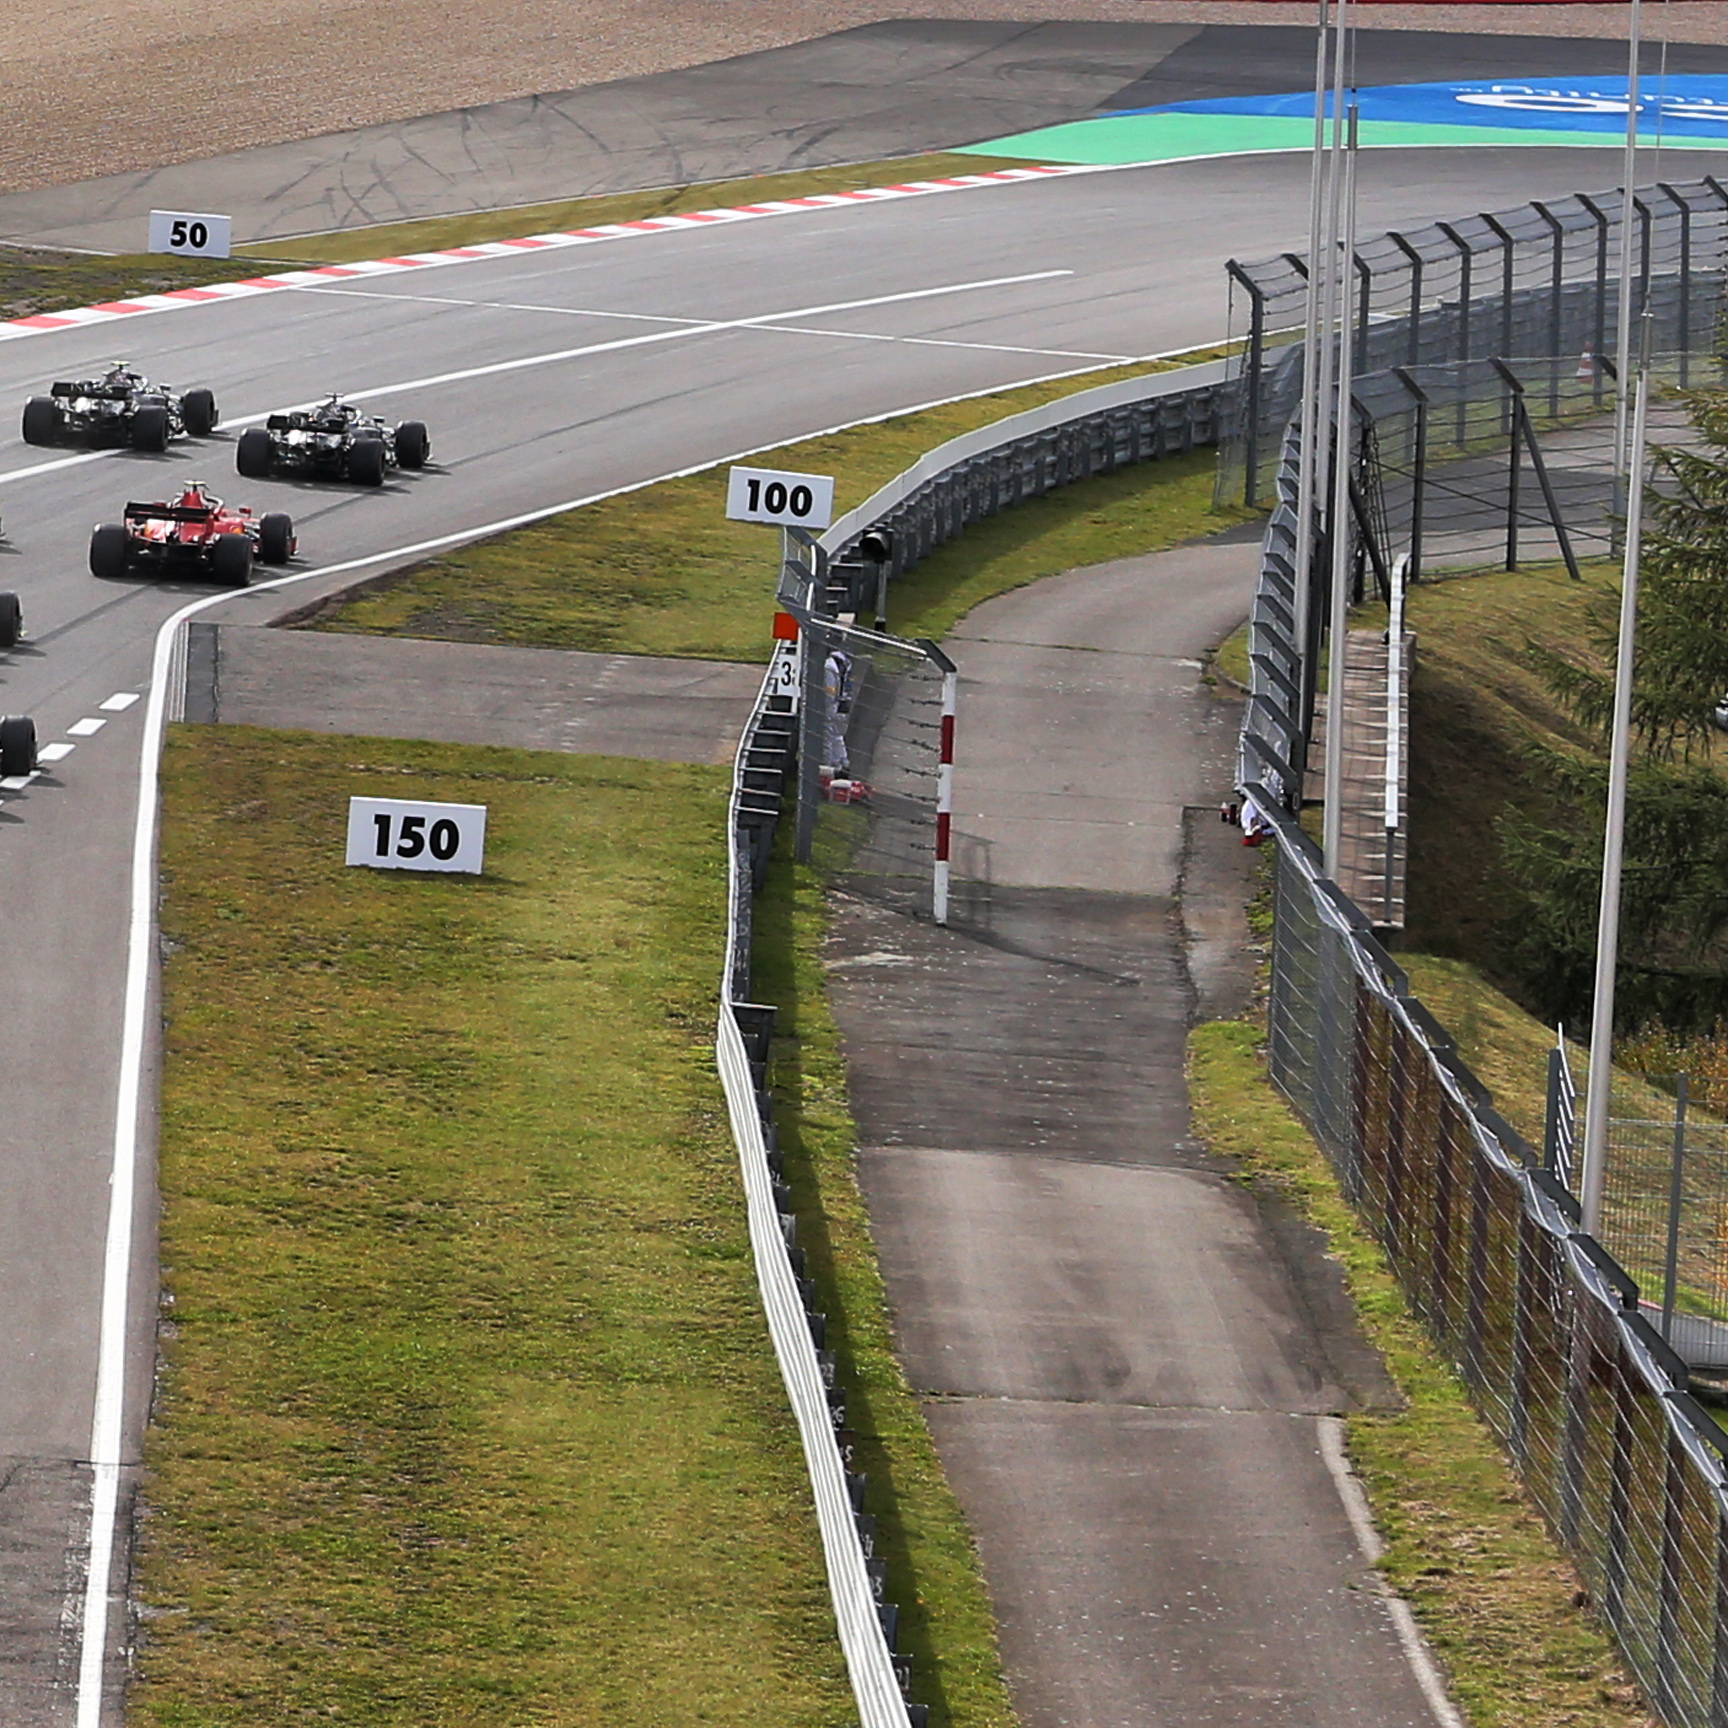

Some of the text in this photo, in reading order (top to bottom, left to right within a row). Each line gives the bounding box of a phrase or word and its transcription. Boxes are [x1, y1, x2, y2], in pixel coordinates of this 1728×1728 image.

[170, 220, 208, 248] 50
[747, 478, 813, 517] 100
[781, 660, 792, 686] 3
[374, 814, 459, 861] 150
